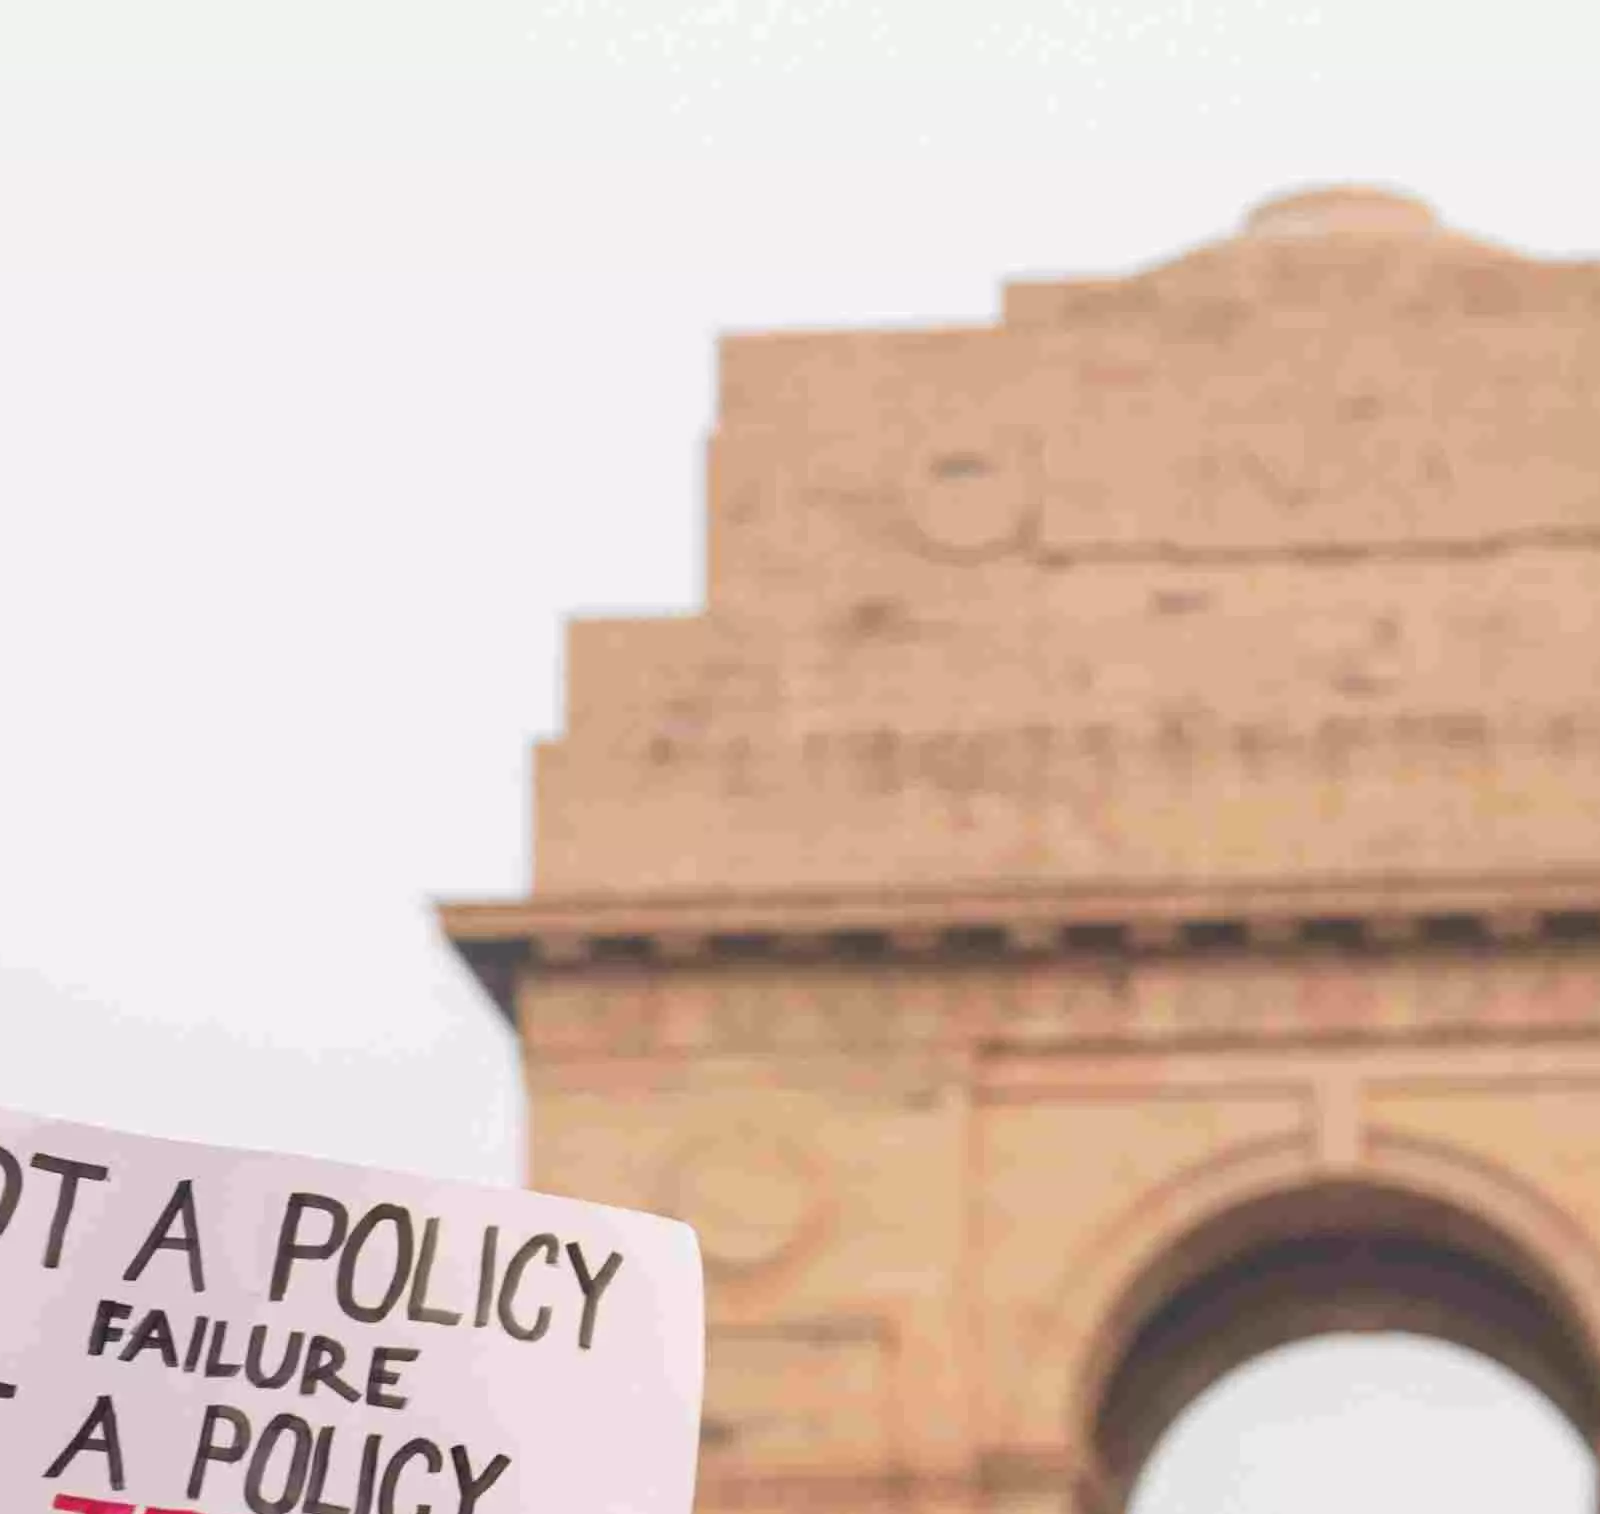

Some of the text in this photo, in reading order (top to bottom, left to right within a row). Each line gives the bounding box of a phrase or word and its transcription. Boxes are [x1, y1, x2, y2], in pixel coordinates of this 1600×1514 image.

[122, 1178, 205, 1293] A
[268, 1191, 623, 1351] POLICY
[87, 1300, 422, 1411] FAILURE
[43, 1395, 125, 1493] A
